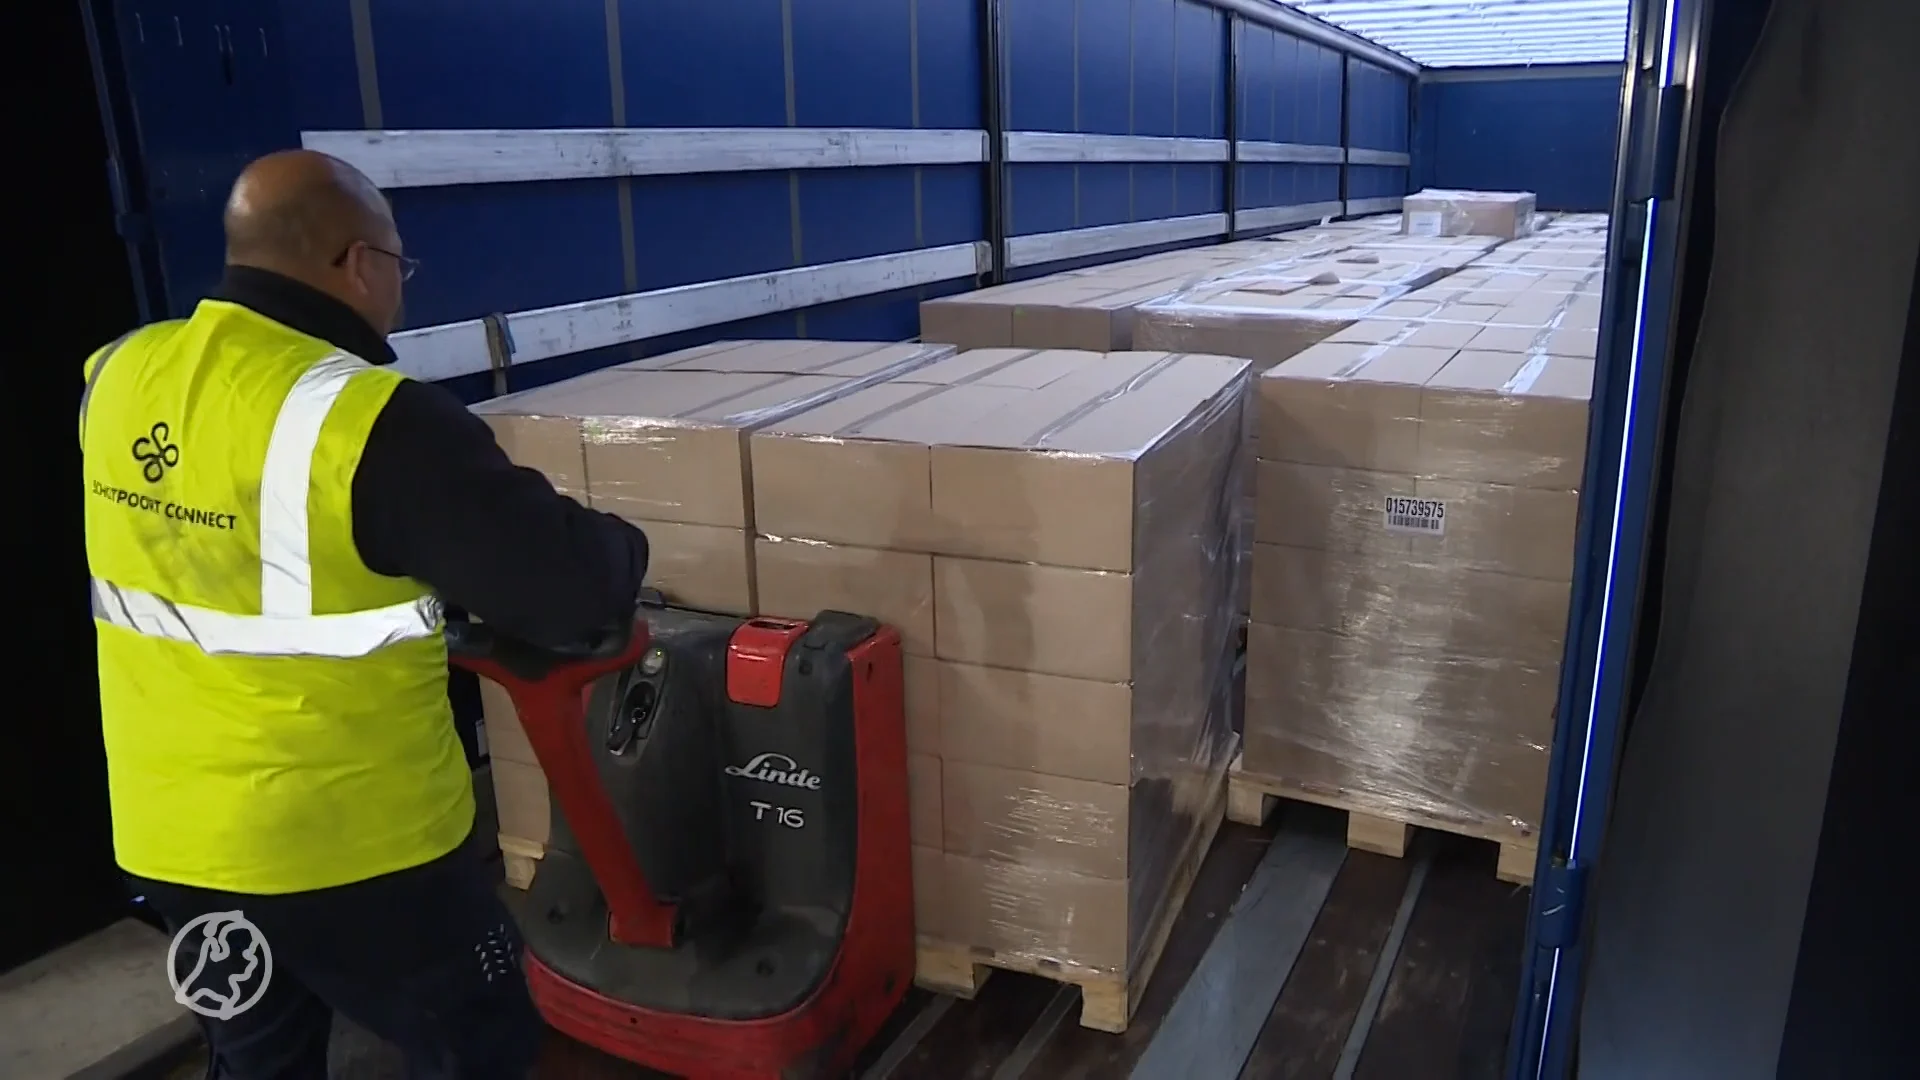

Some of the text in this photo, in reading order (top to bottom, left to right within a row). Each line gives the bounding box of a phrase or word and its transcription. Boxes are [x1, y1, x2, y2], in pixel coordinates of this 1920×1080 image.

[165, 503, 237, 529] CONNECT
[1385, 497, 1444, 518] 015739575
[724, 752, 822, 790] Linde
